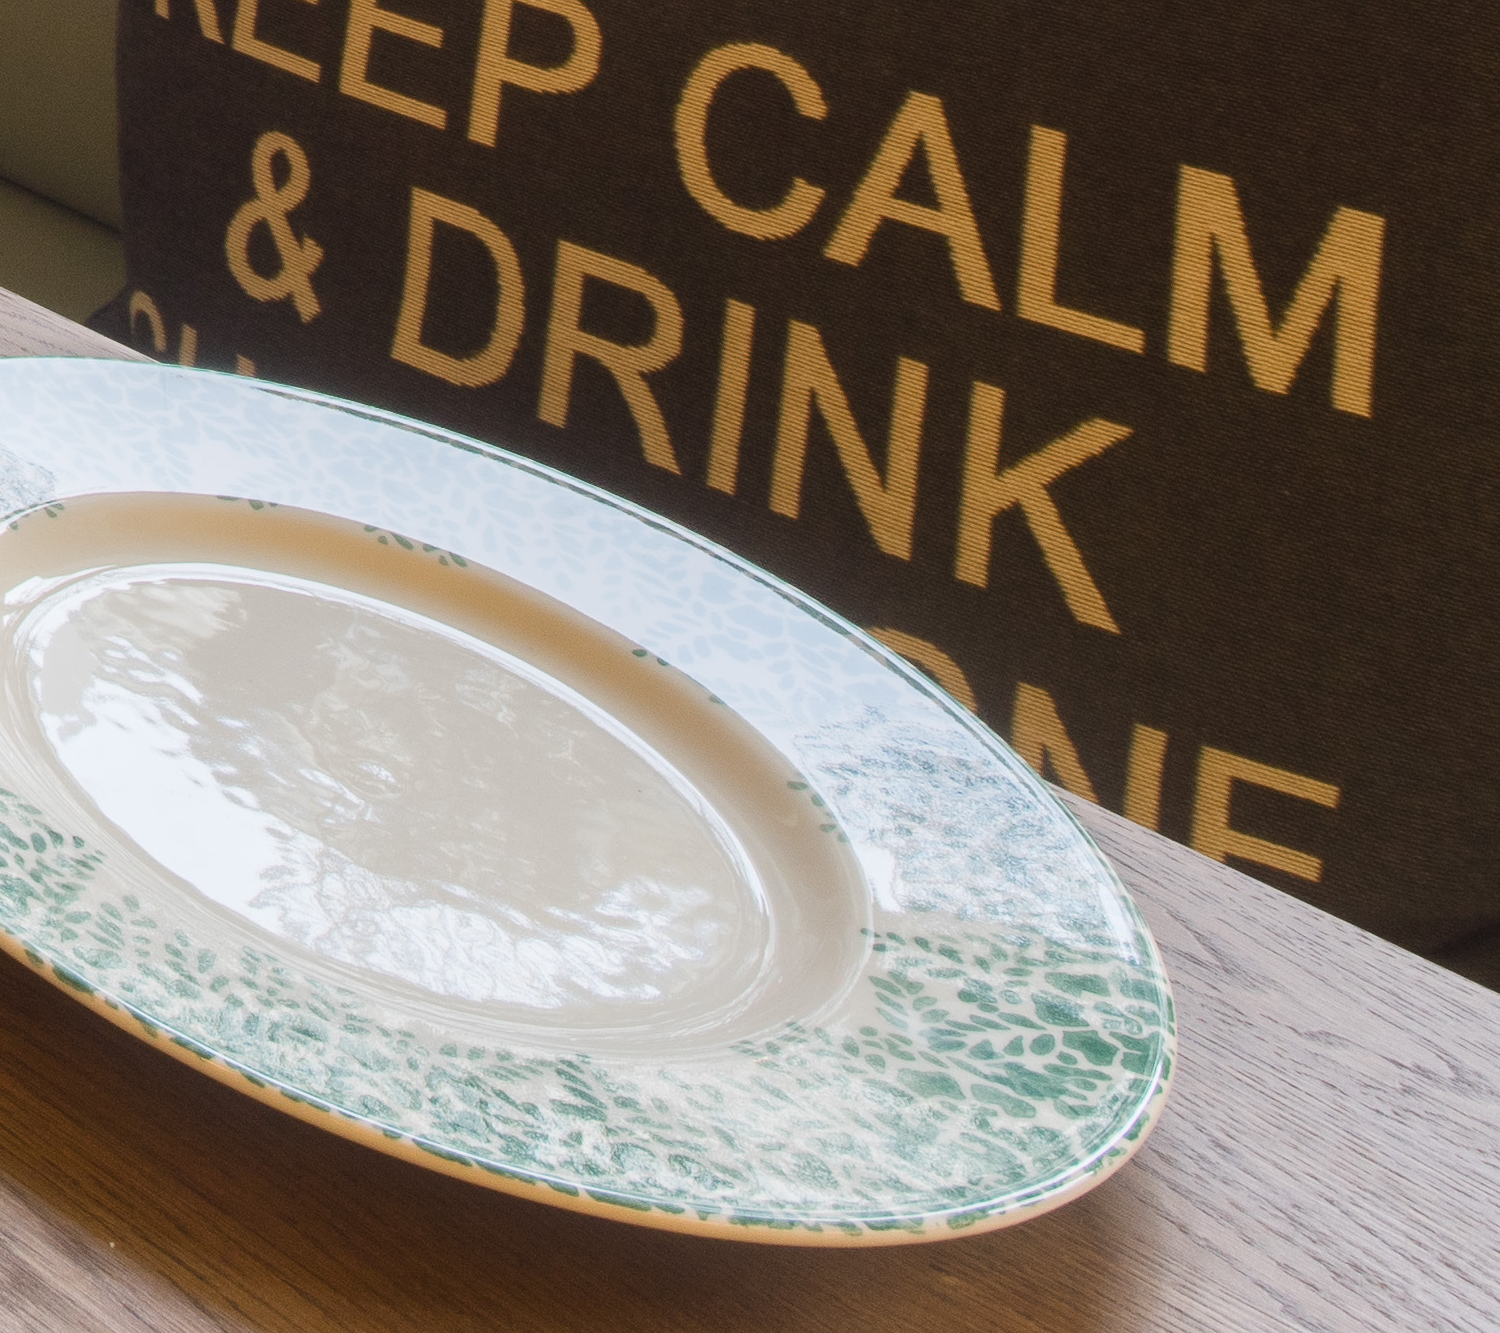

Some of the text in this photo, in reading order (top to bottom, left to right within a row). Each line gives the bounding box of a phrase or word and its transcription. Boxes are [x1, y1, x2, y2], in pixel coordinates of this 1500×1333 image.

[223, 130, 1135, 633] & DRINK
[673, 42, 1385, 420] CALM
